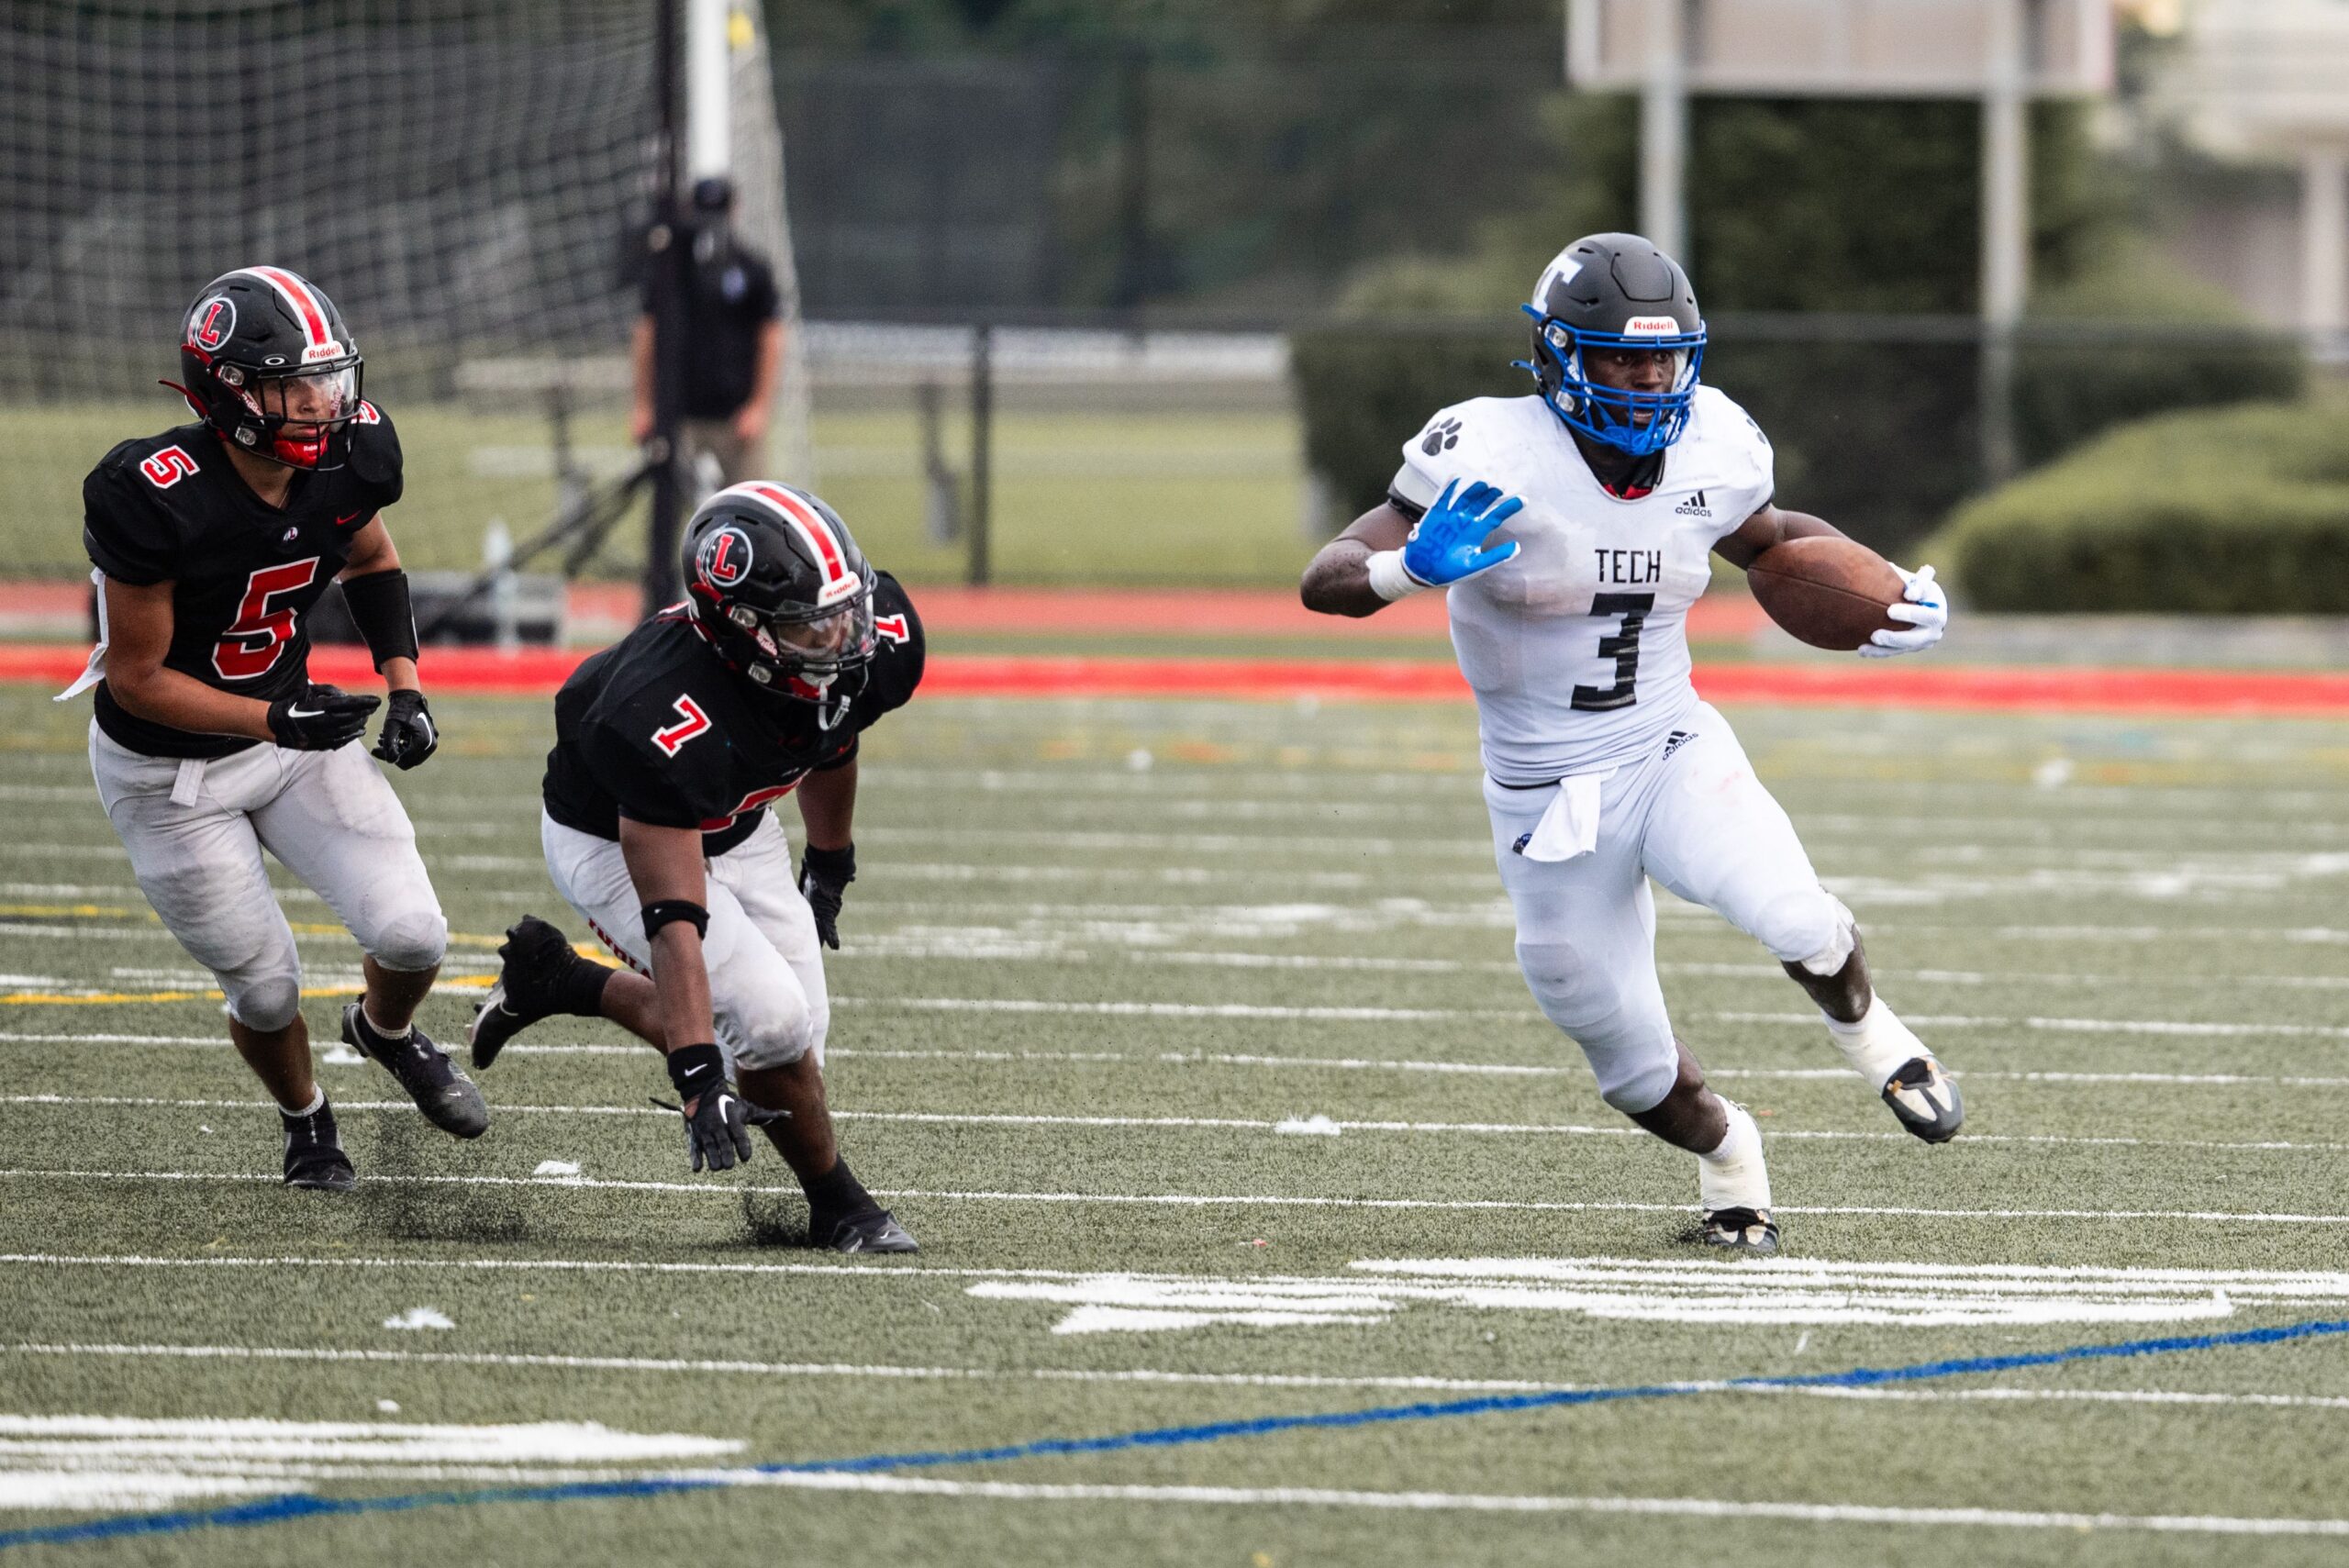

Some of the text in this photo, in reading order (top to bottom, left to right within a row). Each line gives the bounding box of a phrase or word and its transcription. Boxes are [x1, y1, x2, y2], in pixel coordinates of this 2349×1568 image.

[1532, 253, 1585, 314] T
[199, 302, 224, 345] L
[1633, 320, 1674, 330] Riddell
[308, 345, 340, 359] Riddell
[140, 445, 201, 489] 5
[1675, 506, 1712, 517] adidas
[712, 534, 737, 580] L
[1595, 549, 1662, 584] TECH
[211, 556, 320, 680] 5
[1570, 592, 1655, 712] 3
[651, 693, 713, 759] 7
[1662, 733, 1699, 762] adidas
